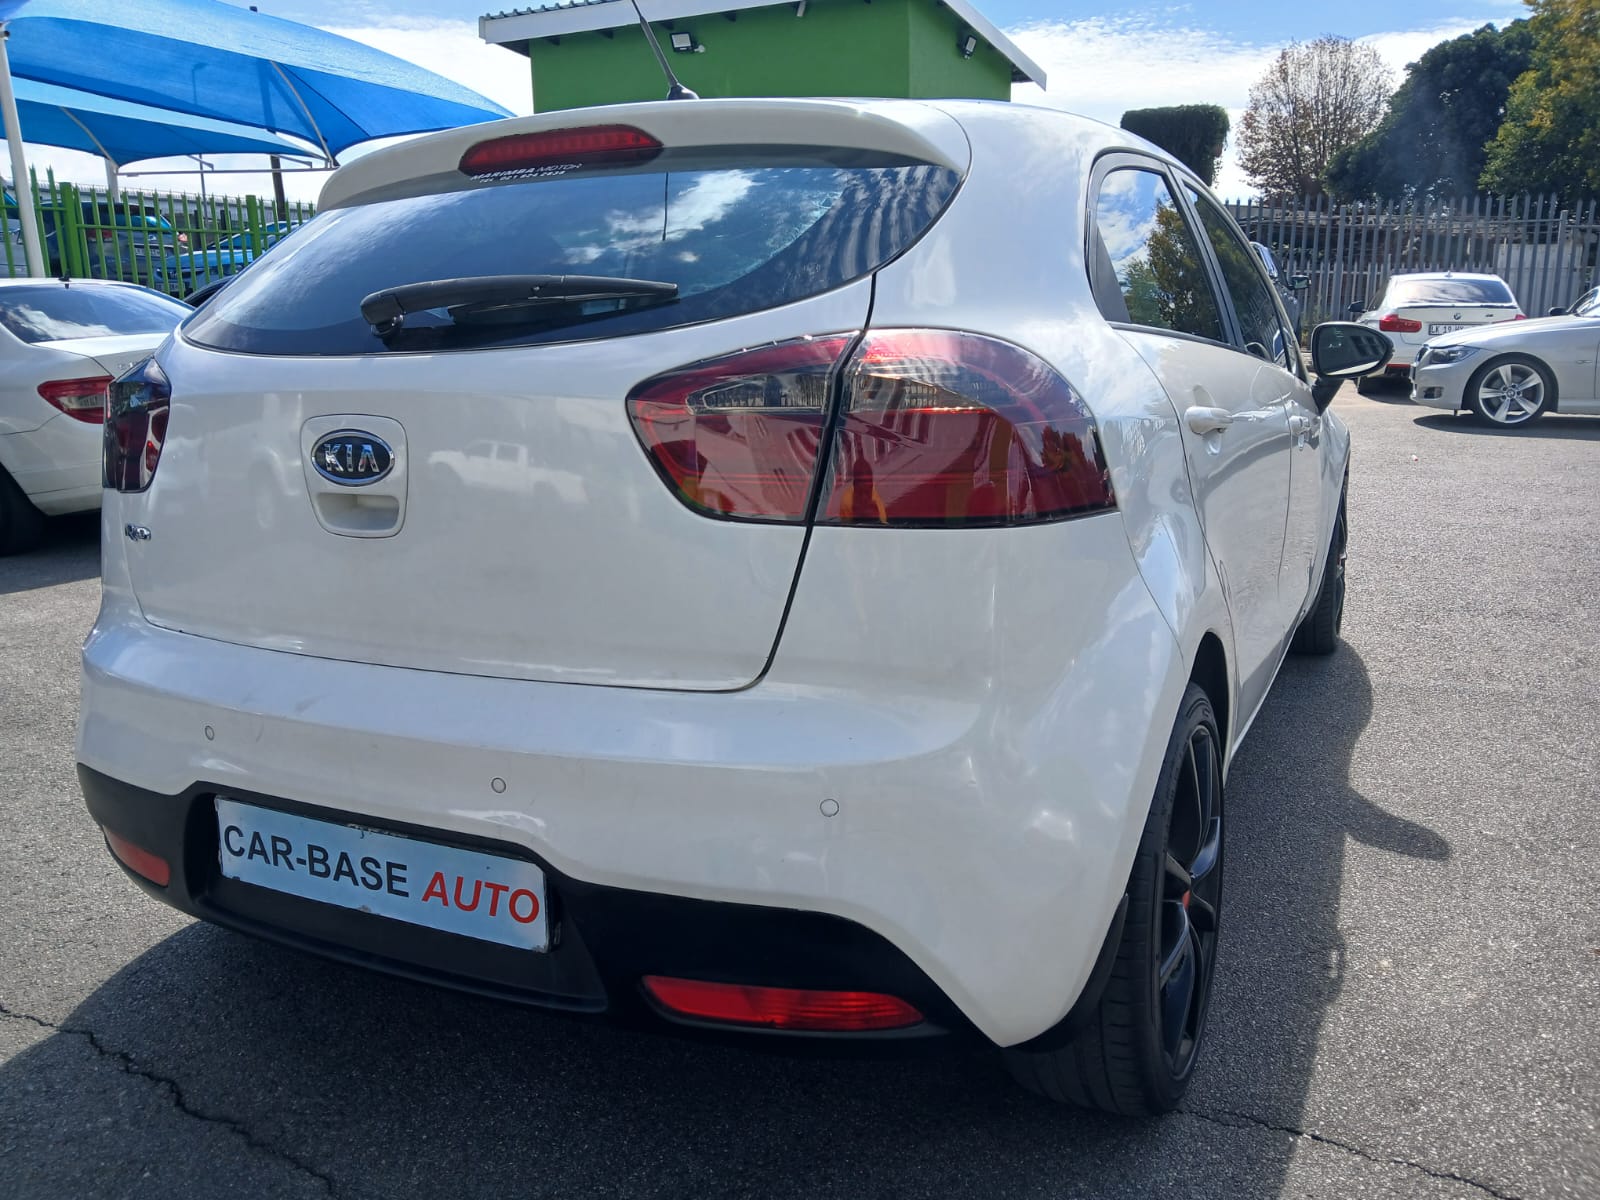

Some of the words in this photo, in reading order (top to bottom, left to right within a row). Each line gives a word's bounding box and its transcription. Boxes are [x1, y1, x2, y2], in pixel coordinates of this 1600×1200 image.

[322, 443, 380, 473] KIA
[224, 825, 409, 898] CAR-BASE
[421, 871, 540, 924] AUTO
